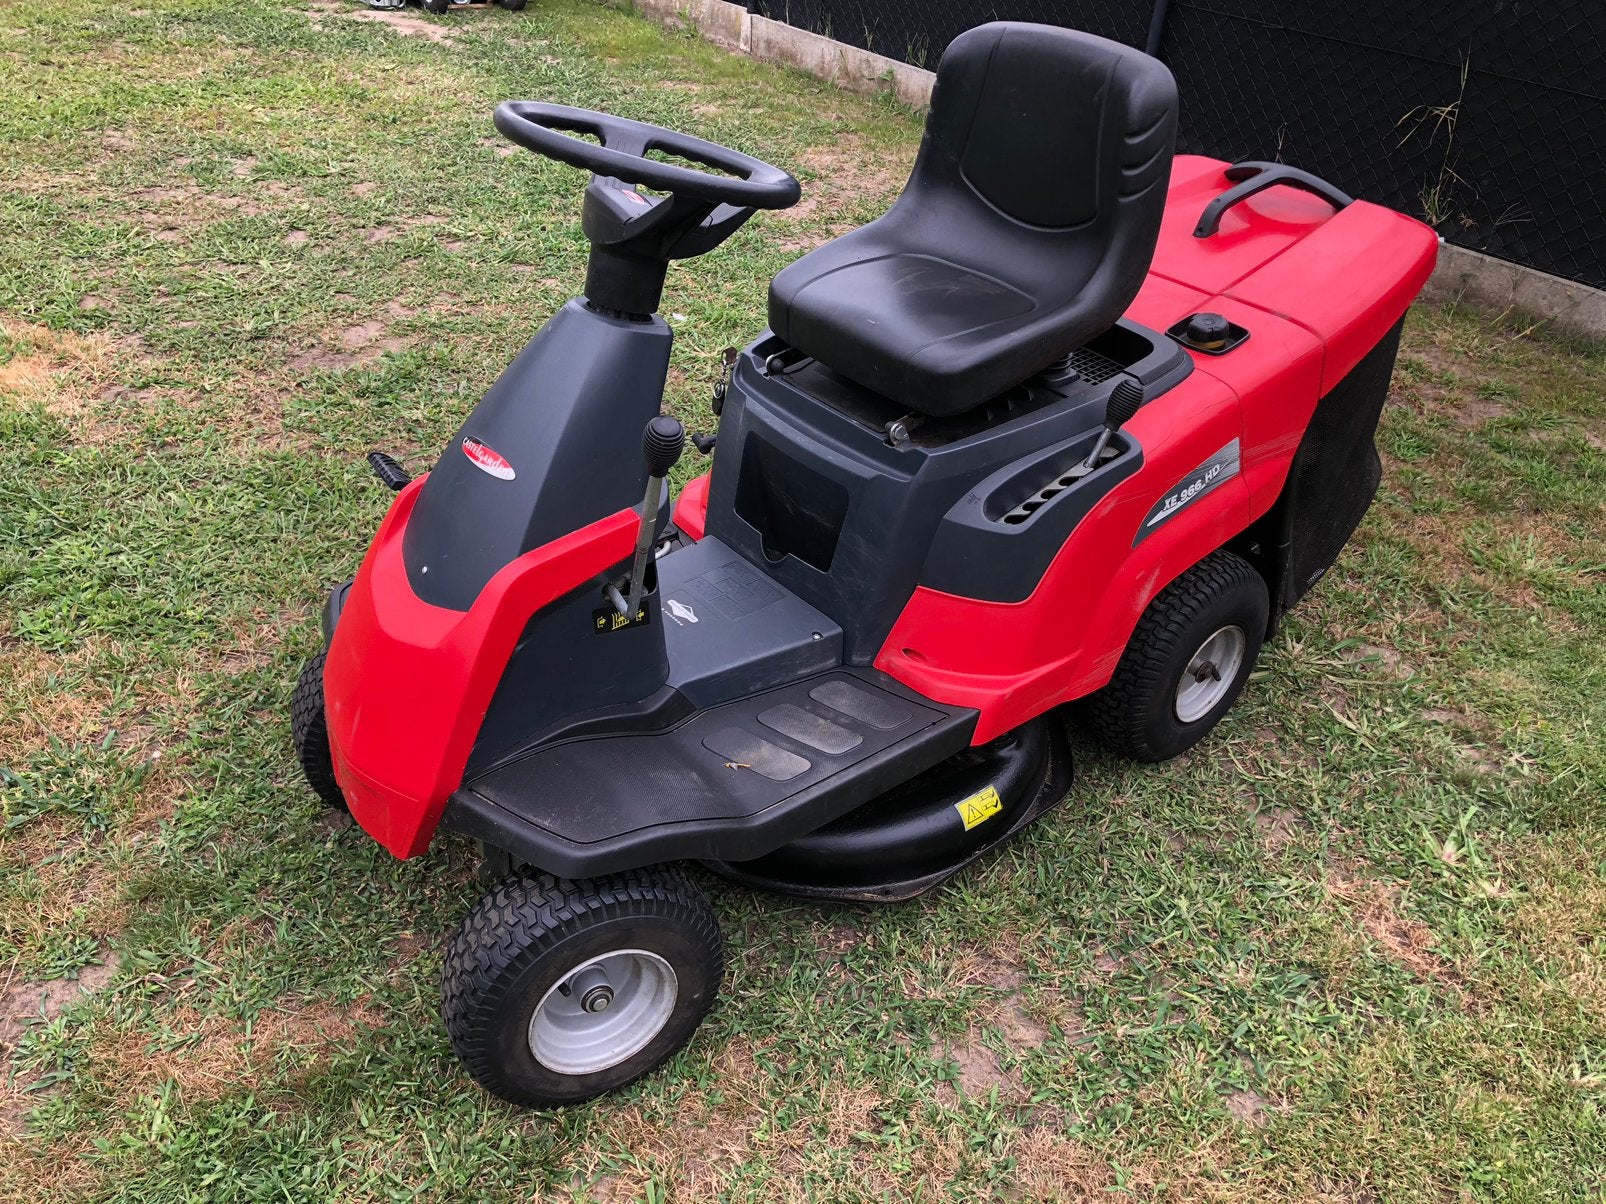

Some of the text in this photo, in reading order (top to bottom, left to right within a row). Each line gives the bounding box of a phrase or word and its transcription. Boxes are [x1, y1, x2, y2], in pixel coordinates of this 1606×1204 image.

[1162, 463, 1221, 511] XE 966 HD
